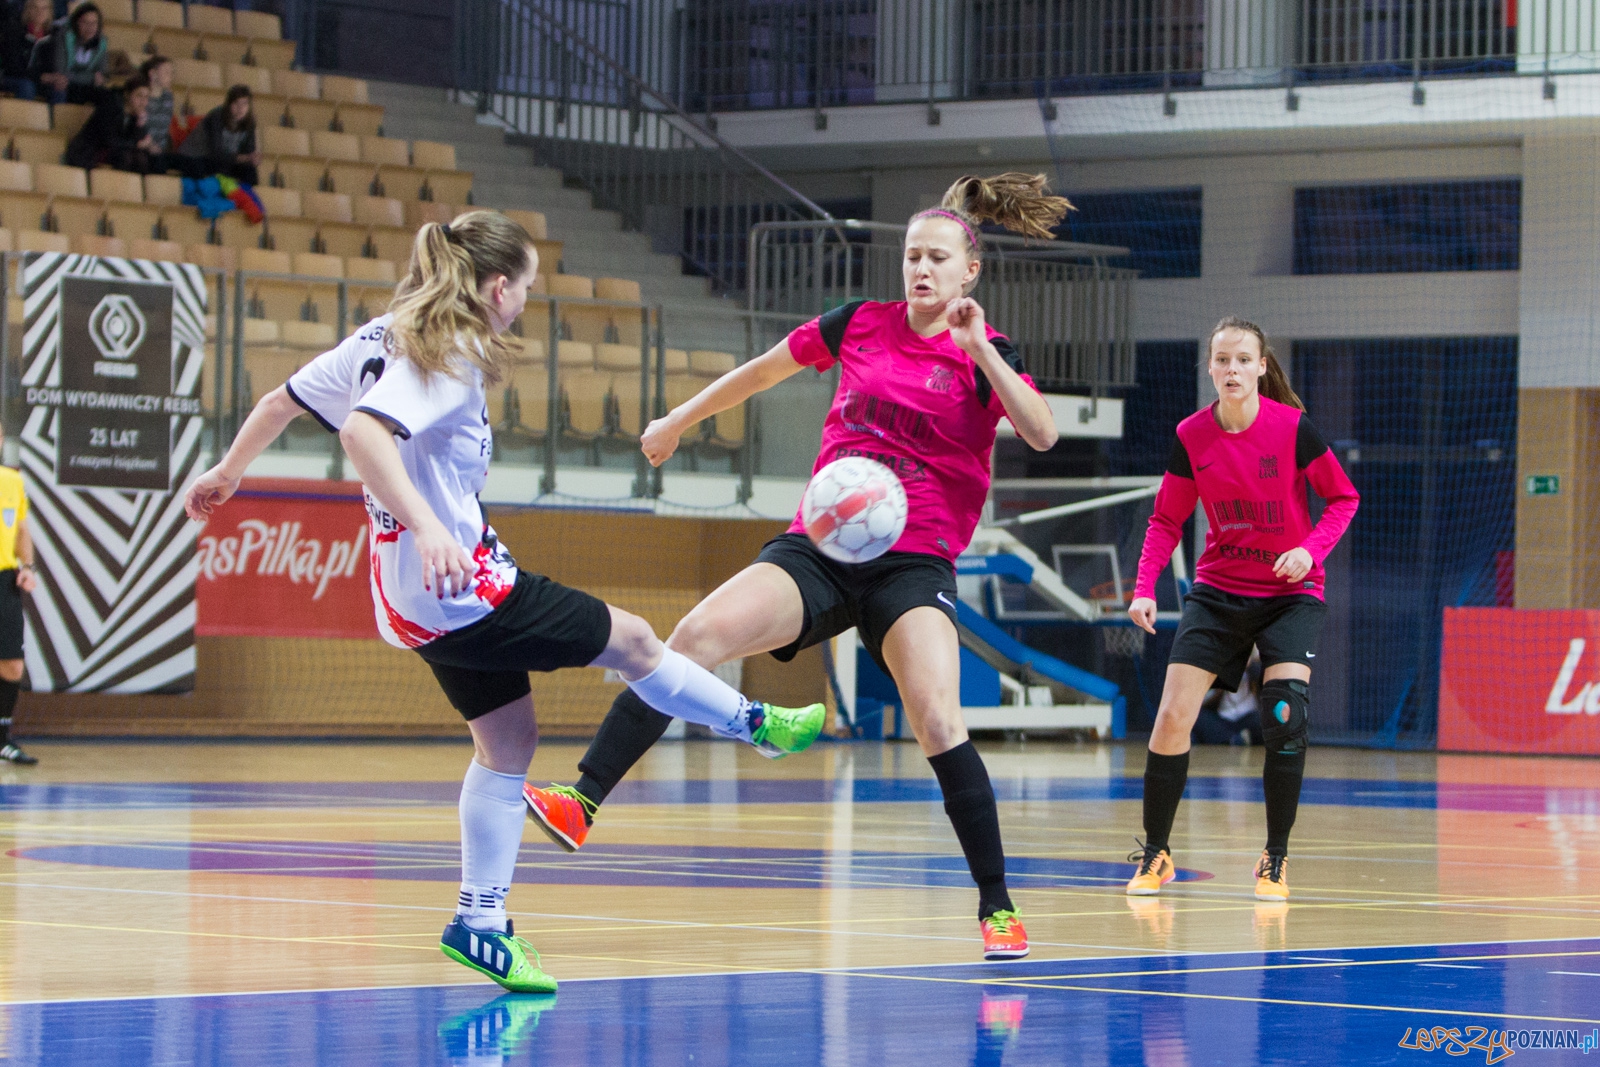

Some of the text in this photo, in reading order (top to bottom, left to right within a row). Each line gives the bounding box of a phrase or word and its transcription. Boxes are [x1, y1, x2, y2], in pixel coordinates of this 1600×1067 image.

[27, 388, 200, 413] DOM WYDAWNICZY REBIS
[89, 428, 139, 447] 25 LAT
